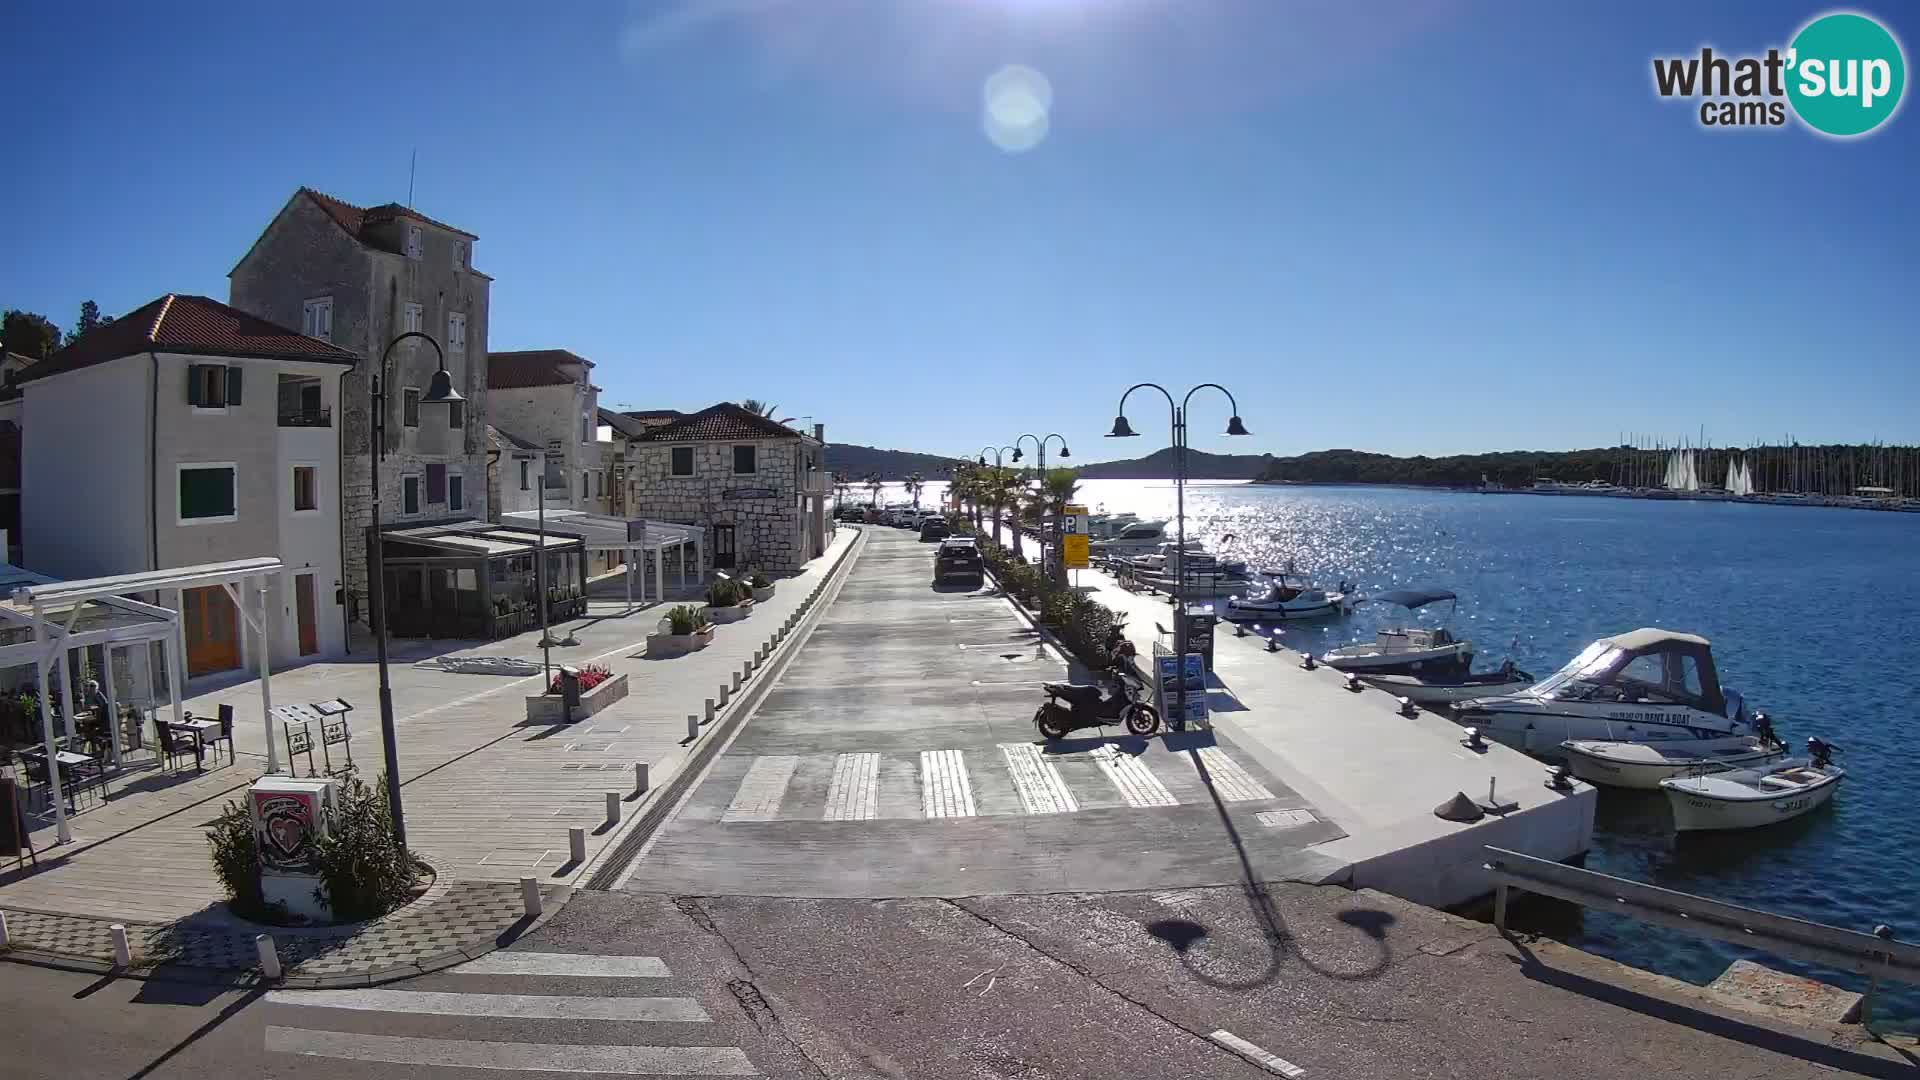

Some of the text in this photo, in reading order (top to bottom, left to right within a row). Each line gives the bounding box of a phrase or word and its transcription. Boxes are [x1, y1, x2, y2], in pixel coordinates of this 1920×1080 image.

[1065, 516, 1076, 533] P
[1644, 712, 1665, 722] RENT
[1671, 713, 1690, 724] BOAT
